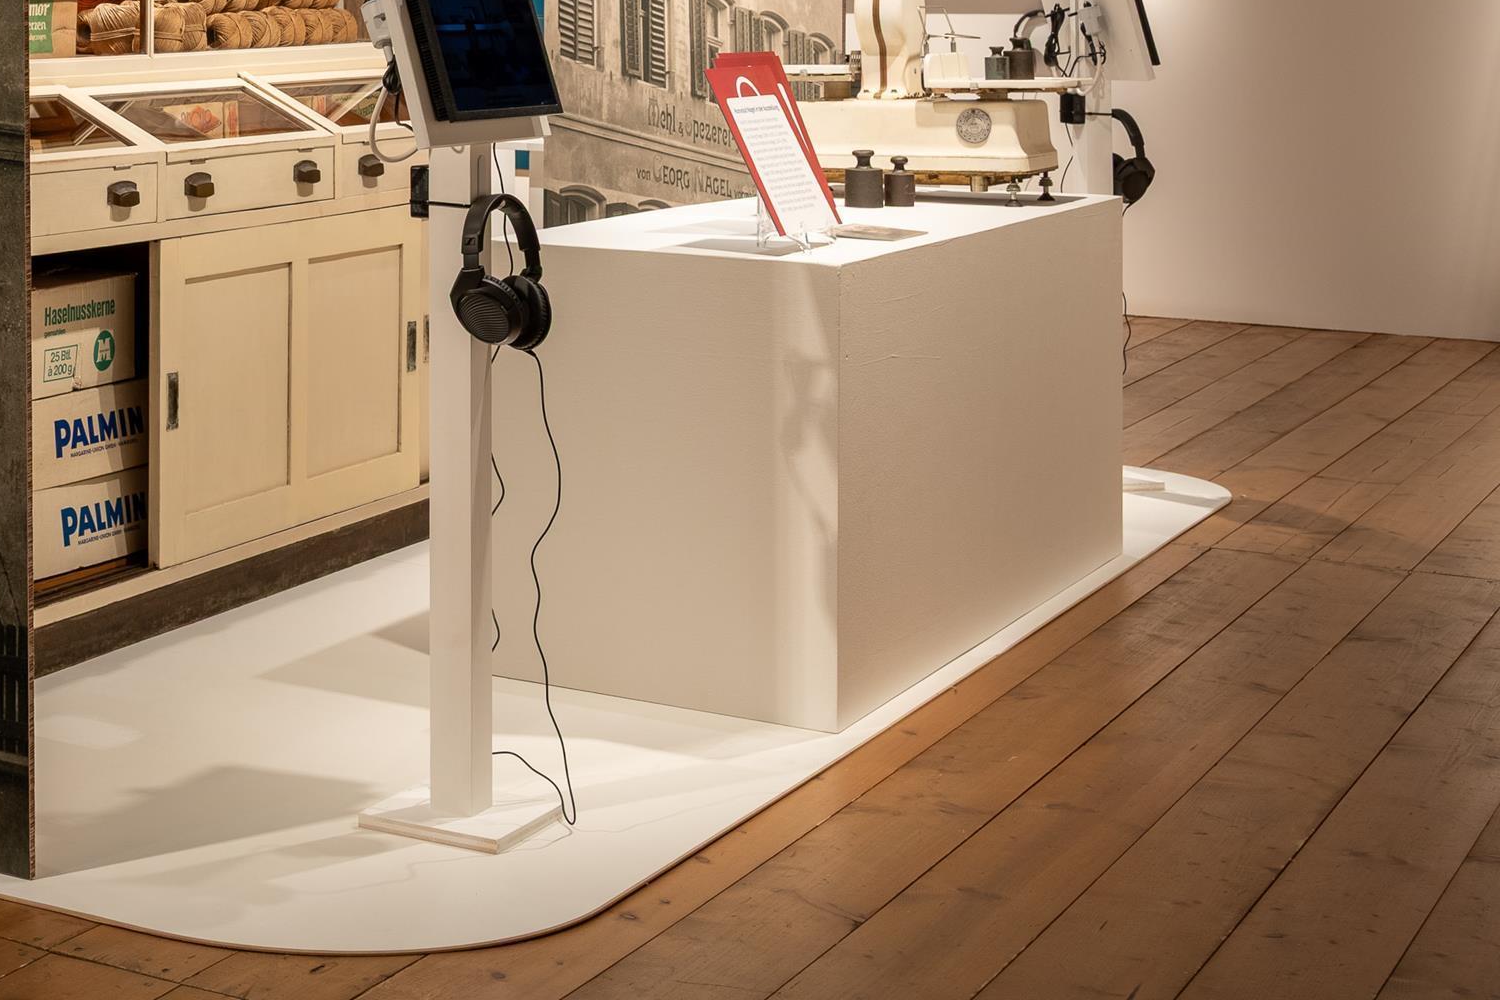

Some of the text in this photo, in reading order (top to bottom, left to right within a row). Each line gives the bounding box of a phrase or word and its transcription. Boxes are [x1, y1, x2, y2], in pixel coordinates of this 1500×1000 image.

[29, 3, 50, 17] mor
[648, 96, 676, 136] Mehl
[636, 168, 651, 180] von
[652, 154, 690, 190] GEORG
[44, 298, 116, 326] Haselnusskerne
[48, 364, 72, 376] à 200 g
[50, 352, 60, 362] 25
[54, 406, 144, 458] PALMIN
[60, 492, 146, 547] PALMIN
